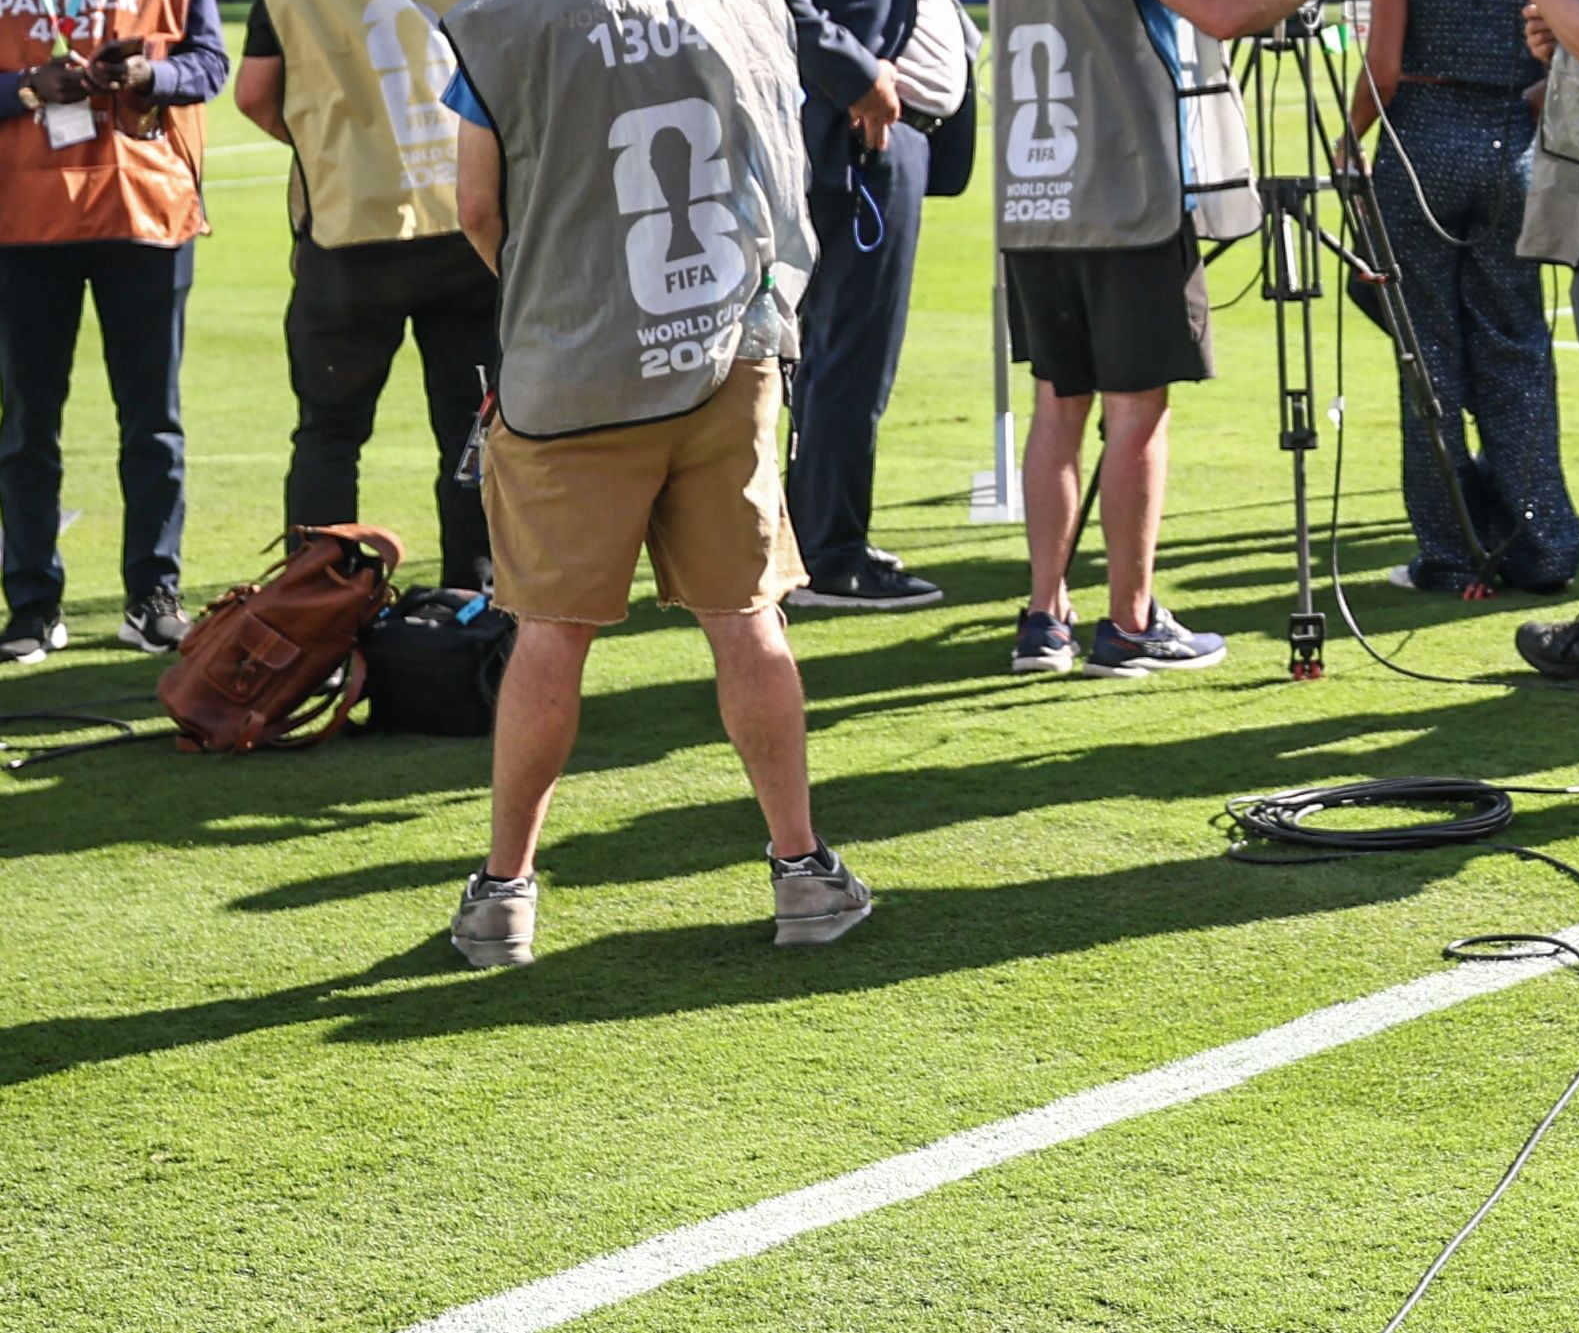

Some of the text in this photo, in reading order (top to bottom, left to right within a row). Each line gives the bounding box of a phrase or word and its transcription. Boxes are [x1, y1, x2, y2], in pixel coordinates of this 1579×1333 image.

[587, 16, 709, 69] 1304
[1027, 146, 1056, 163] FIFA
[1007, 181, 1073, 197] WORLD CUP
[1003, 197, 1072, 223] 2026
[664, 264, 718, 294] FIFA
[636, 302, 747, 347] WORLD CUP
